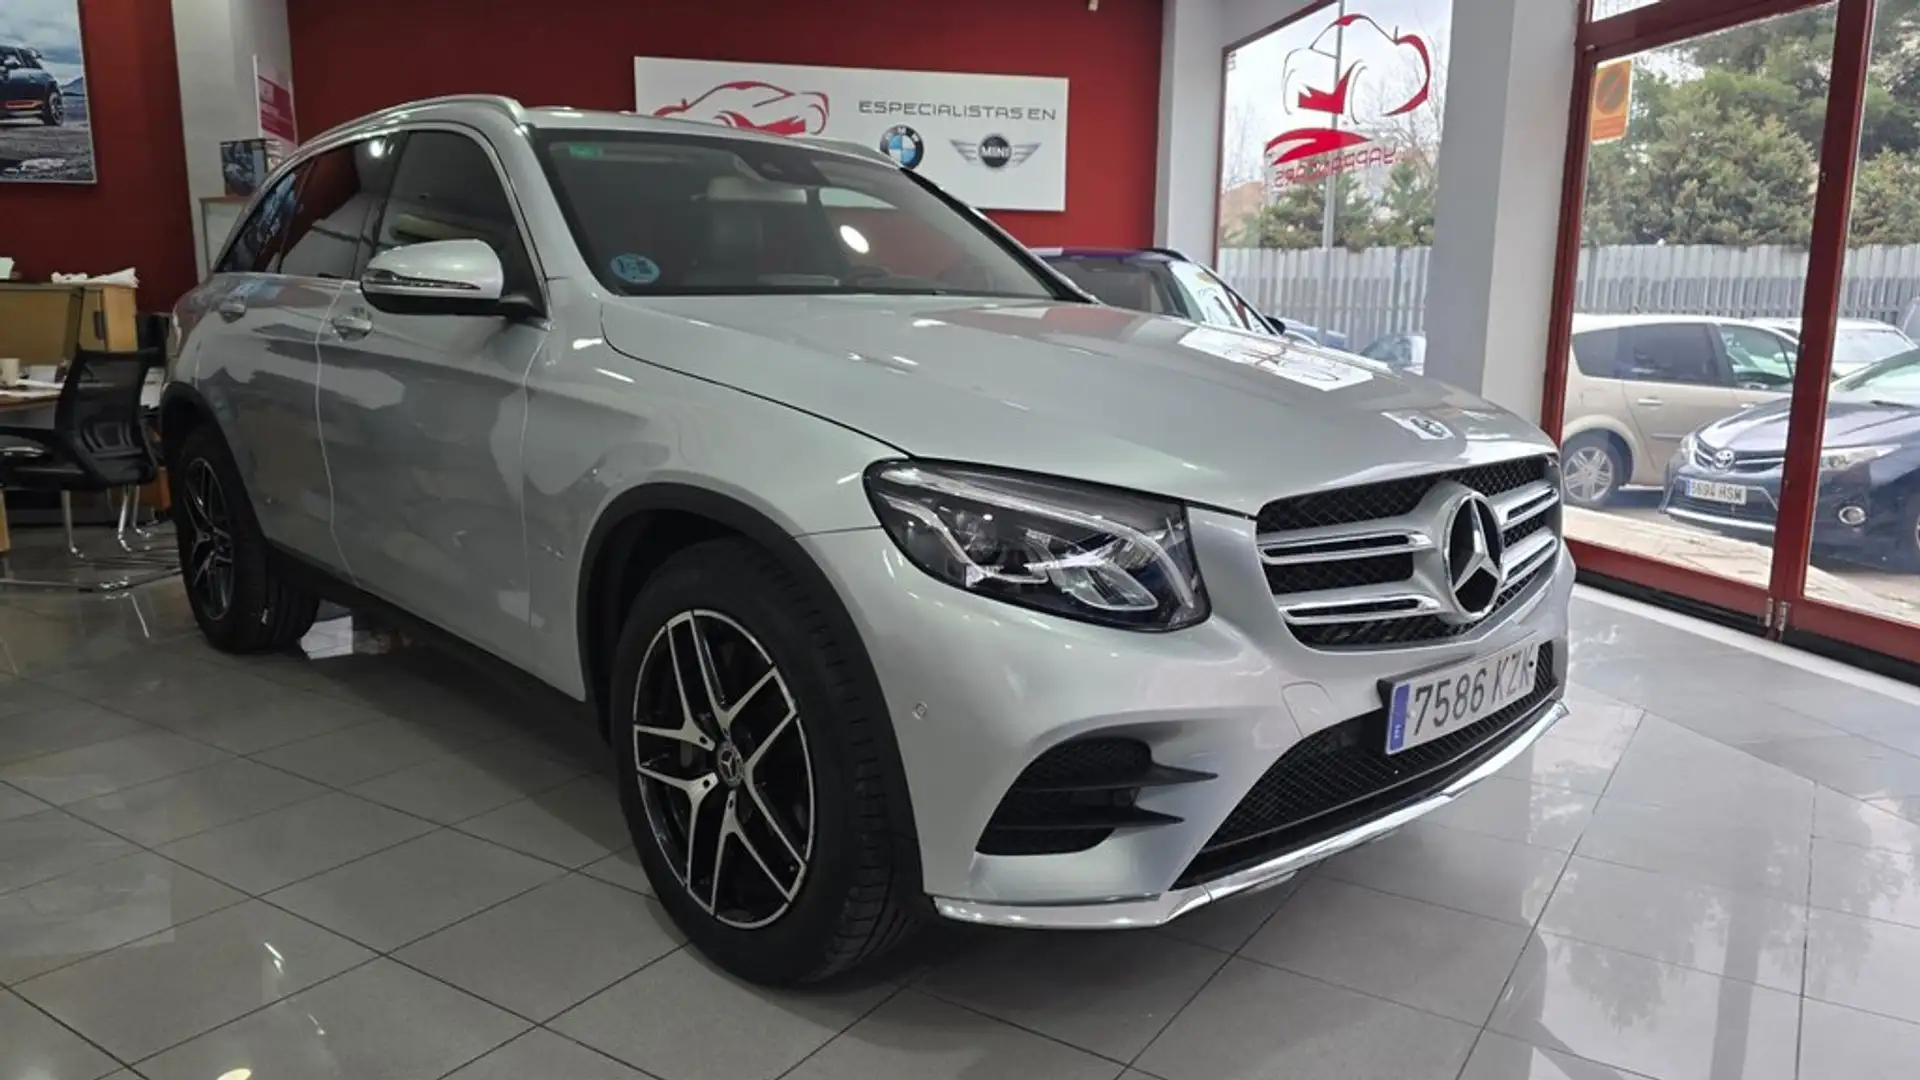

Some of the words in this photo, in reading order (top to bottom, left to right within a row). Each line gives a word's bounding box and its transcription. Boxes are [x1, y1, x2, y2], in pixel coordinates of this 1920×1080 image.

[858, 100, 1024, 120] ESPECIALISTAS
[1026, 108, 1057, 121] EN
[980, 145, 1011, 159] MINI
[1413, 667, 1488, 737] 7586
[1491, 642, 1536, 705] KZK
